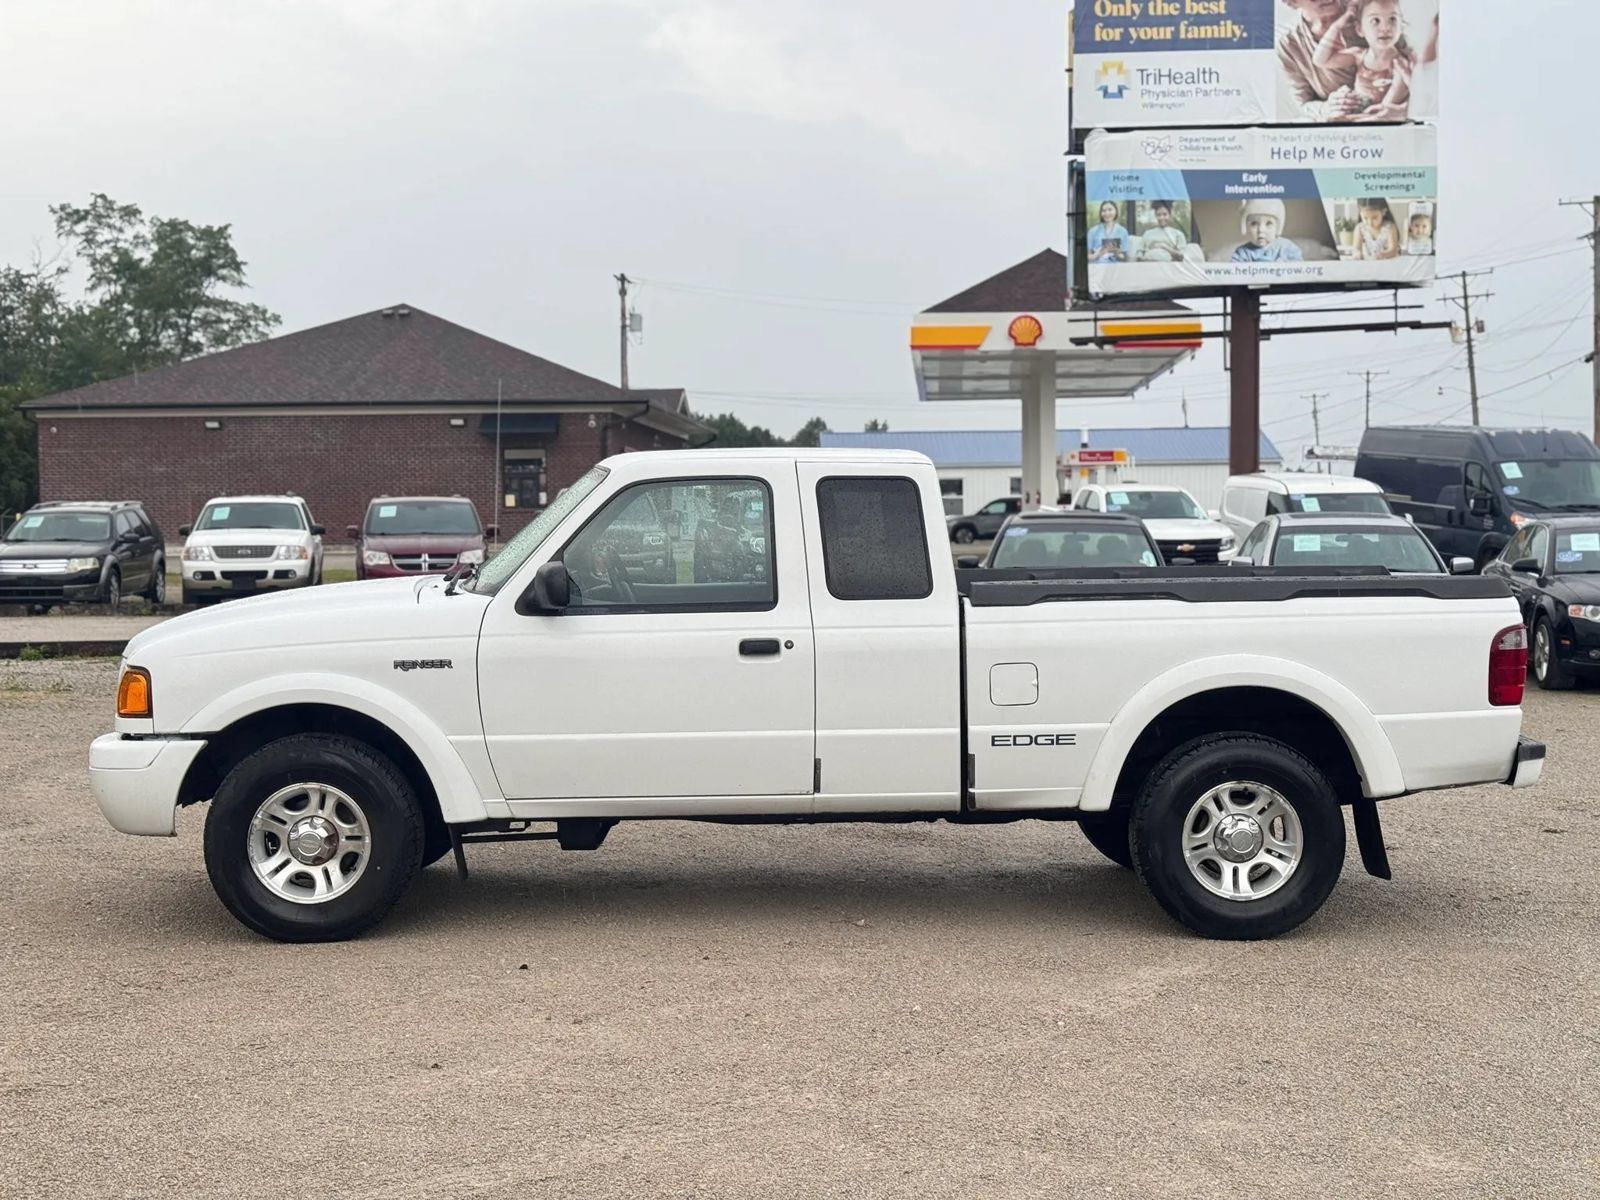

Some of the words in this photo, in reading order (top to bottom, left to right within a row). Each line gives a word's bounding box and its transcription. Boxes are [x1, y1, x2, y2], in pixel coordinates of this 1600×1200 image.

[1094, 0, 1143, 20] Only
[1148, 0, 1181, 16] the
[1185, 0, 1227, 15] best
[1094, 23, 1124, 41] for
[1129, 26, 1175, 44] your
[1179, 20, 1248, 42] family.
[1136, 67, 1220, 86] TriHealth
[1140, 88, 1193, 101] Physician
[1195, 87, 1242, 98] Partners
[1178, 135, 1226, 144] Department
[1270, 146, 1308, 163] Help
[1312, 146, 1336, 160] Me
[1340, 146, 1384, 160] Grow
[1112, 174, 1140, 182] Home
[1242, 173, 1268, 184] Early
[1354, 170, 1426, 180] Developmental
[1108, 185, 1144, 195] Visiting
[1224, 184, 1285, 194] Intervention
[1364, 183, 1416, 193] Screenings
[1204, 265, 1324, 277] www.helpmegrow.org
[393, 659, 454, 672] RANGER
[991, 733, 1076, 747] EDGE
